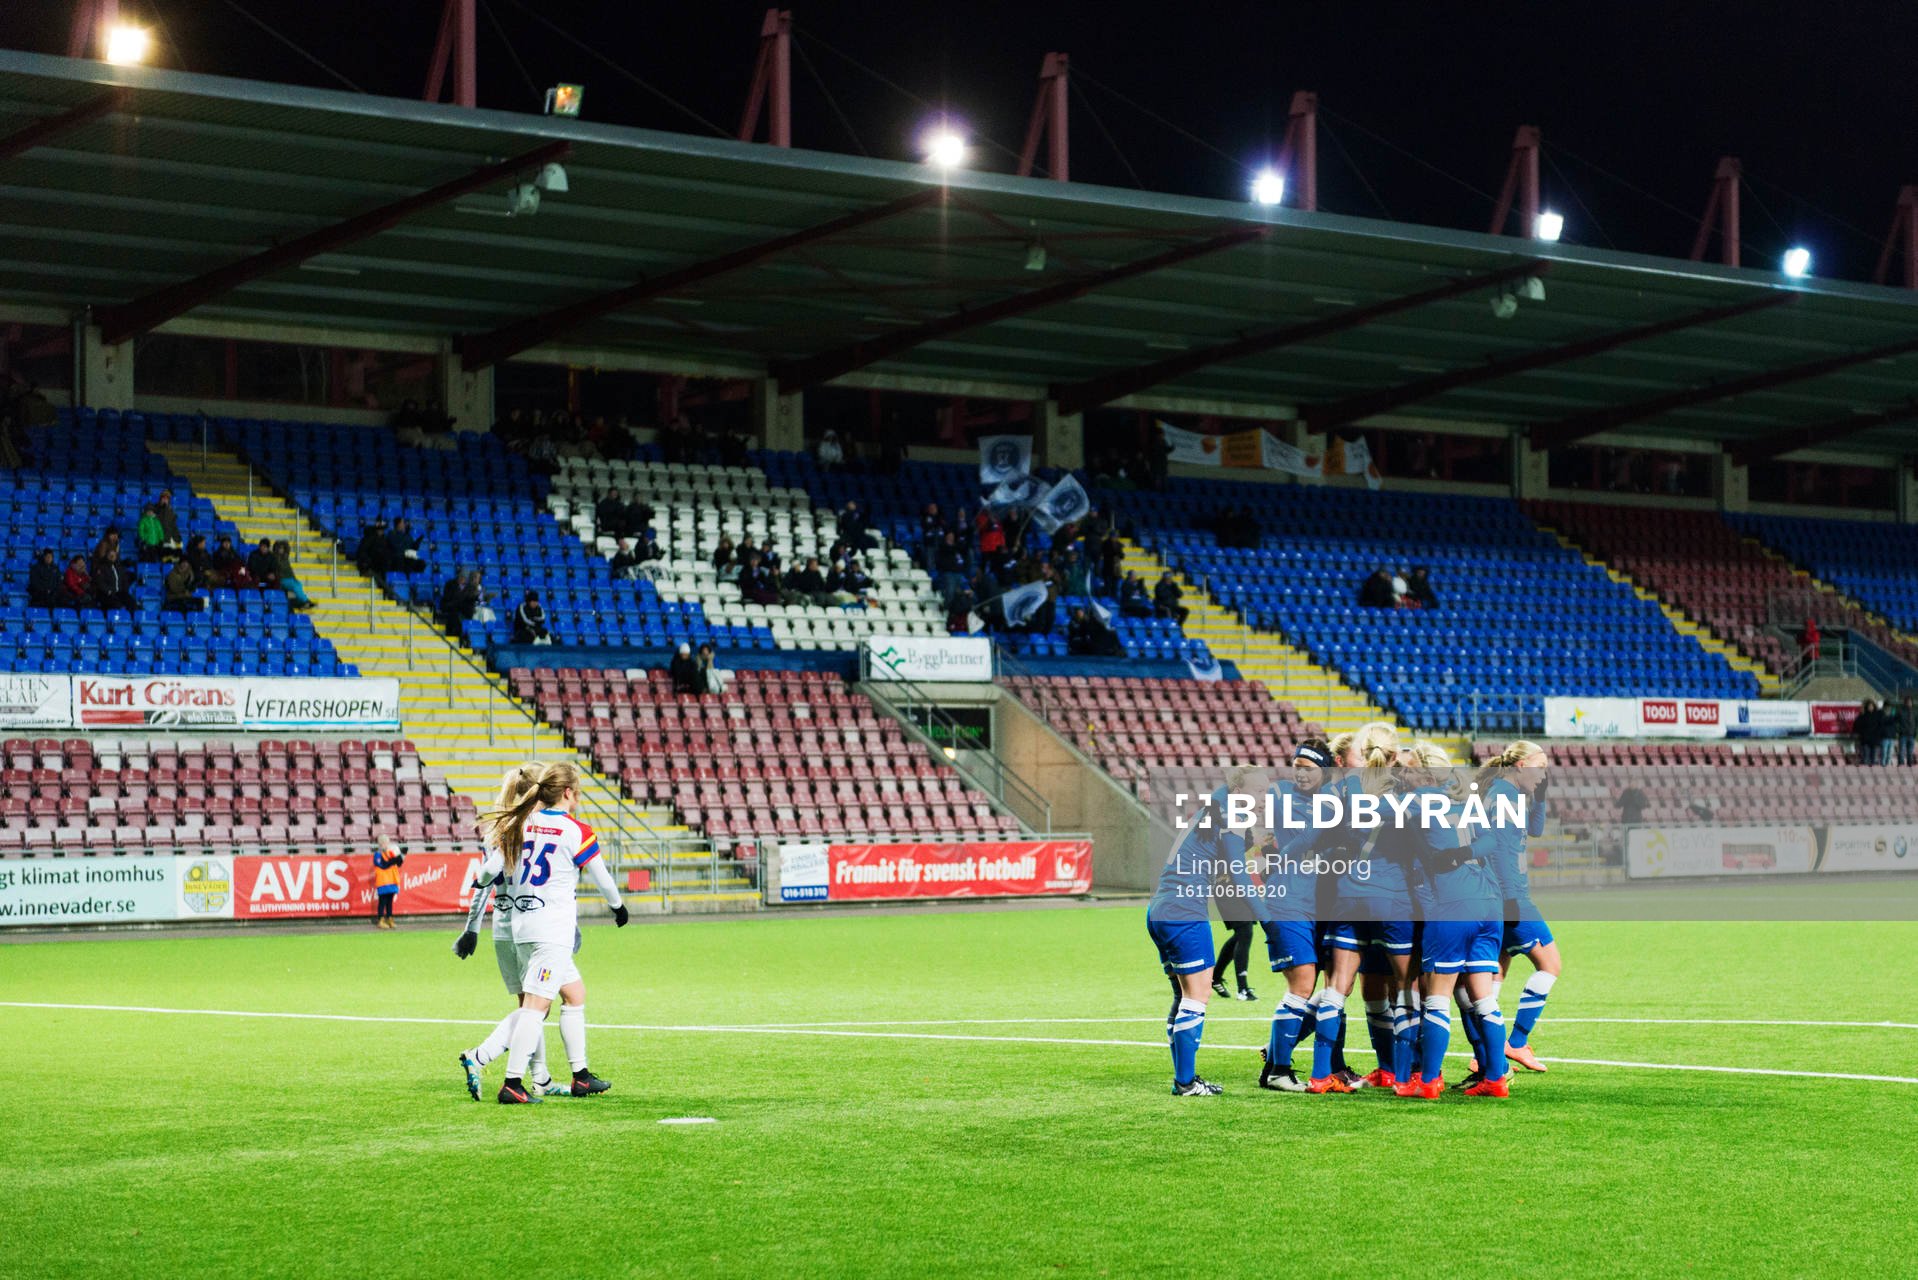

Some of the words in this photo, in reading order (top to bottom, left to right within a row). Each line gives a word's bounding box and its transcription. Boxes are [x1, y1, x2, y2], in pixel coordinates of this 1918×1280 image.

[907, 648, 984, 670] ByggPartner
[80, 681, 136, 705] Kurt
[144, 681, 236, 706] Görans
[1645, 705, 1676, 719] TOOLS
[1687, 707, 1717, 721] TOOLS
[22, 867, 80, 885] klimat
[86, 864, 165, 883] inomhus
[250, 860, 351, 901] AVIS
[403, 863, 448, 891] harder!
[835, 857, 897, 885] Framåt
[897, 857, 924, 883] för
[923, 856, 977, 882] svensk
[978, 855, 1037, 880] fotboll!
[0, 897, 136, 917] w.innevader.se
